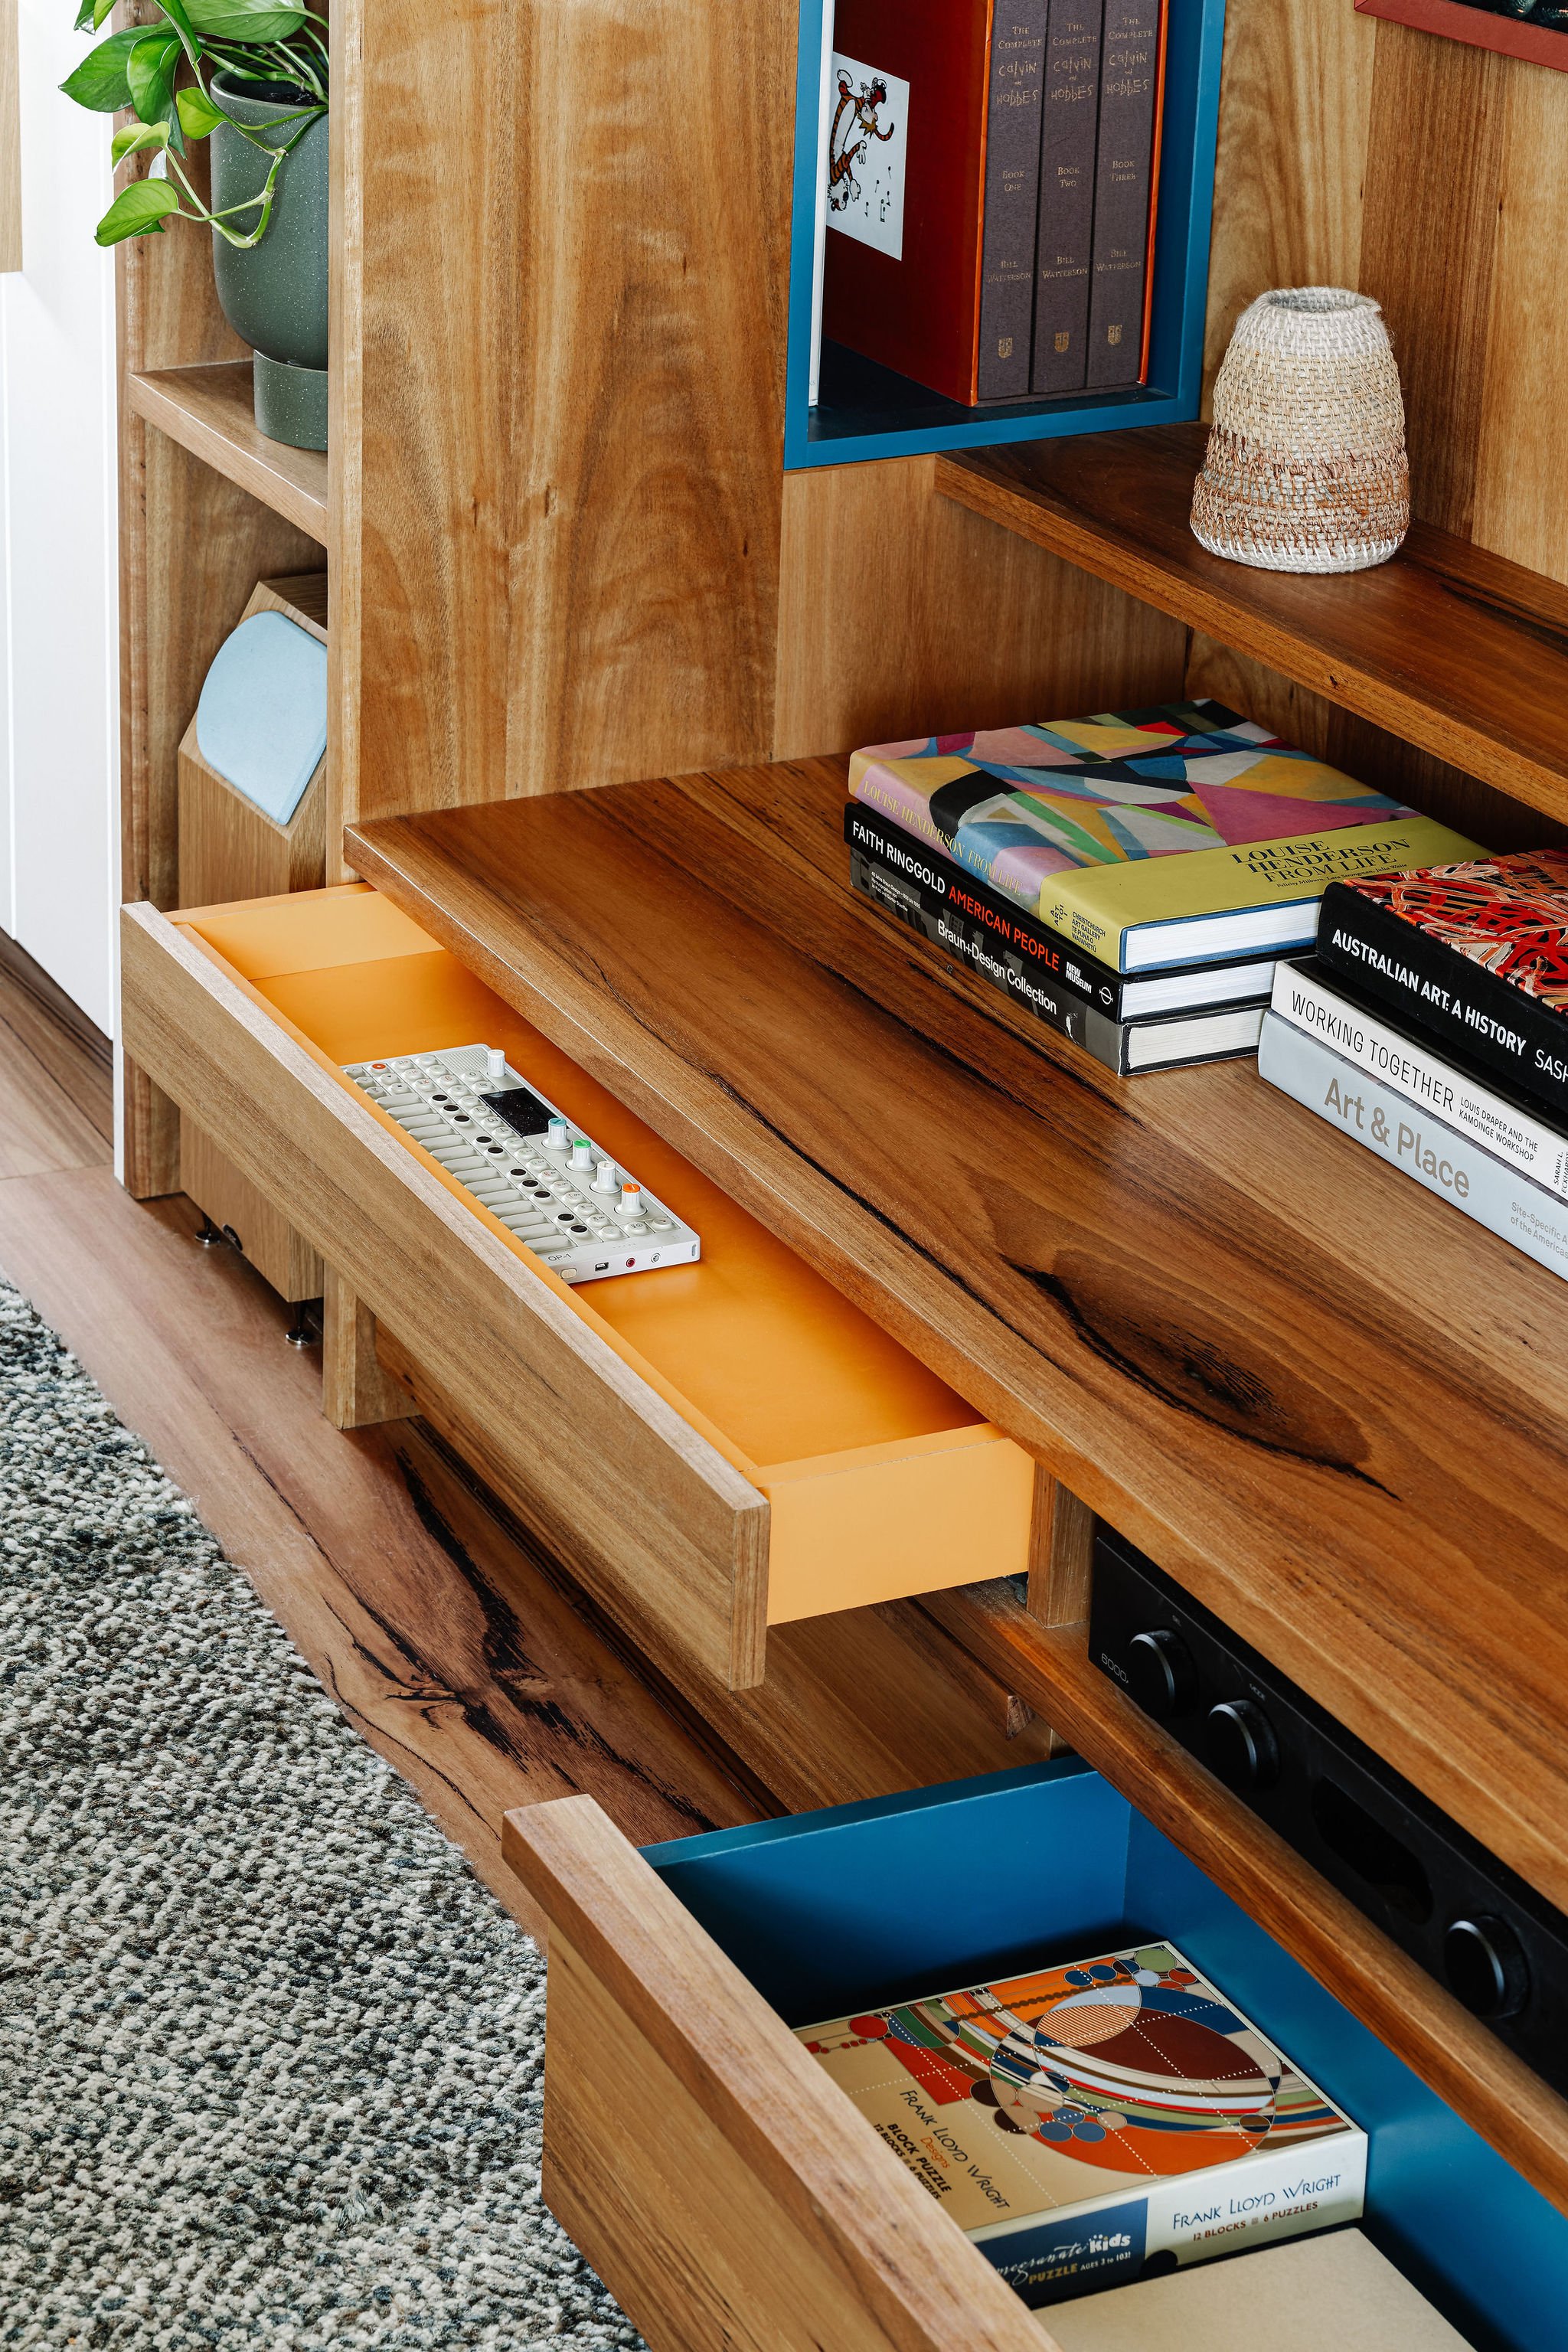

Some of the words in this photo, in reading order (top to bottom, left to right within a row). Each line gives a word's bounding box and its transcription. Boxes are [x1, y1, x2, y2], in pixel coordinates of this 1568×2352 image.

[998, 39, 1042, 49] COMPLETE
[1053, 36, 1096, 46] COMPLETE
[1109, 30, 1152, 40] COMPLETE
[1112, 160, 1135, 168] BOOK
[1043, 268, 1087, 279] WATTERSON
[864, 781, 900, 815] LOUISE
[901, 803, 965, 858] HENDERSON
[968, 850, 996, 879] FROM
[998, 869, 1023, 896] LIFE
[1230, 841, 1329, 864] LOUISE
[1246, 838, 1411, 873] HENDERSON
[1262, 864, 1338, 883] FROM
[1343, 854, 1397, 871] LIFE
[853, 821, 883, 854] FAITH
[887, 843, 946, 893] RINGGOLD
[949, 886, 1011, 939] AMERICAN
[1014, 928, 1059, 971] PEOPLE
[1072, 911, 1106, 936] CHRISTCHURCH
[1072, 919, 1080, 928] ART
[1081, 924, 1100, 940] GALLERY
[938, 919, 1005, 980] Braun+Design
[1007, 968, 1057, 1015] Collection
[1066, 969, 1092, 994] MUSEUM
[1067, 962, 1080, 978] NEW
[1332, 929, 1419, 992] AUSTRALIAN
[1420, 982, 1450, 1011] ART:
[1452, 999, 1462, 1019] A
[1465, 1005, 1527, 1057] HISTORY
[1292, 990, 1364, 1053] WORKING
[1370, 1039, 1453, 1112] TOGETHER
[1325, 1078, 1364, 1130] Art
[1371, 1107, 1390, 1147] &
[1397, 1122, 1469, 1198] Place
[1459, 1109, 1494, 1138] KAMOINGE
[1496, 1132, 1534, 1161] WORKSHOP
[1461, 1097, 1480, 1116] LOUIS
[1481, 1110, 1507, 1133] DRAPER
[1508, 1128, 1523, 1142] AND
[1525, 1137, 1538, 1152] THE
[1511, 1202, 1560, 1240] Site-Specific
[1511, 1217, 1518, 1225] of
[1520, 1220, 1532, 1235] the
[1534, 1230, 1568, 1259] Americas
[548, 1253, 571, 1262] OP-1
[881, 2133, 906, 2157] BLOCKS
[915, 2171, 942, 2200] PUZZLES
[887, 2123, 920, 2155] BLOCK
[916, 2157, 952, 2192] PUZZLE
[900, 2089, 937, 2125] FRANK
[933, 2128, 968, 2162] LLOYD
[967, 2164, 1010, 2208] WRIGHT
[920, 2137, 949, 2168] Designs
[1173, 2206, 1221, 2230] FRANK
[1230, 2192, 1275, 2214] LLOYD
[1282, 2174, 1341, 2198] WRIGHT
[1194, 2233, 1201, 2241] 12
[1204, 2220, 1246, 2238] BLOCKS
[1263, 2214, 1269, 2223] 6
[1272, 2201, 1318, 2220] PUZZLES
[1028, 2263, 1078, 2285] PUZZLE
[1080, 2261, 1098, 2271] AGES
